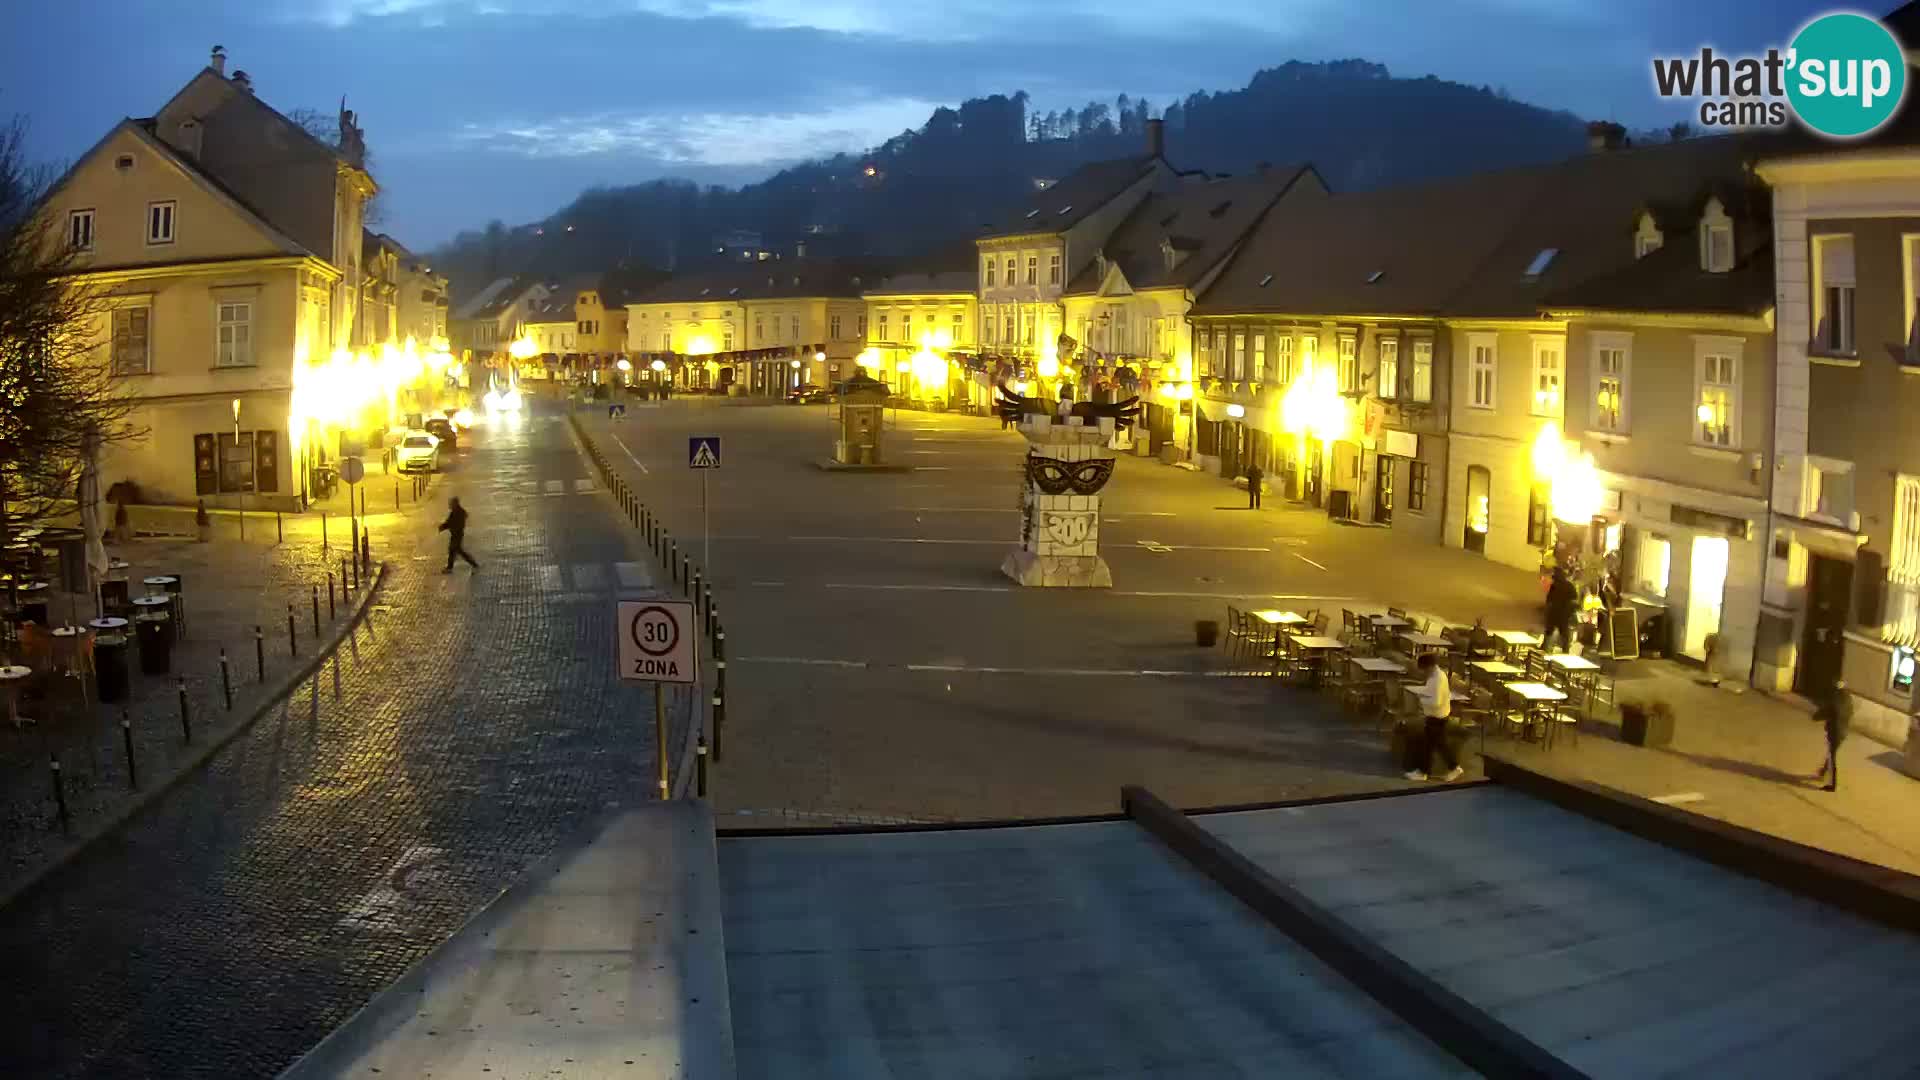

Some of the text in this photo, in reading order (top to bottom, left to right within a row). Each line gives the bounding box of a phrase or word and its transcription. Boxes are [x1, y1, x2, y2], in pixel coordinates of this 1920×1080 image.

[1046, 515, 1088, 545] 200
[643, 622, 668, 643] 30
[634, 659, 679, 677] ZONA
